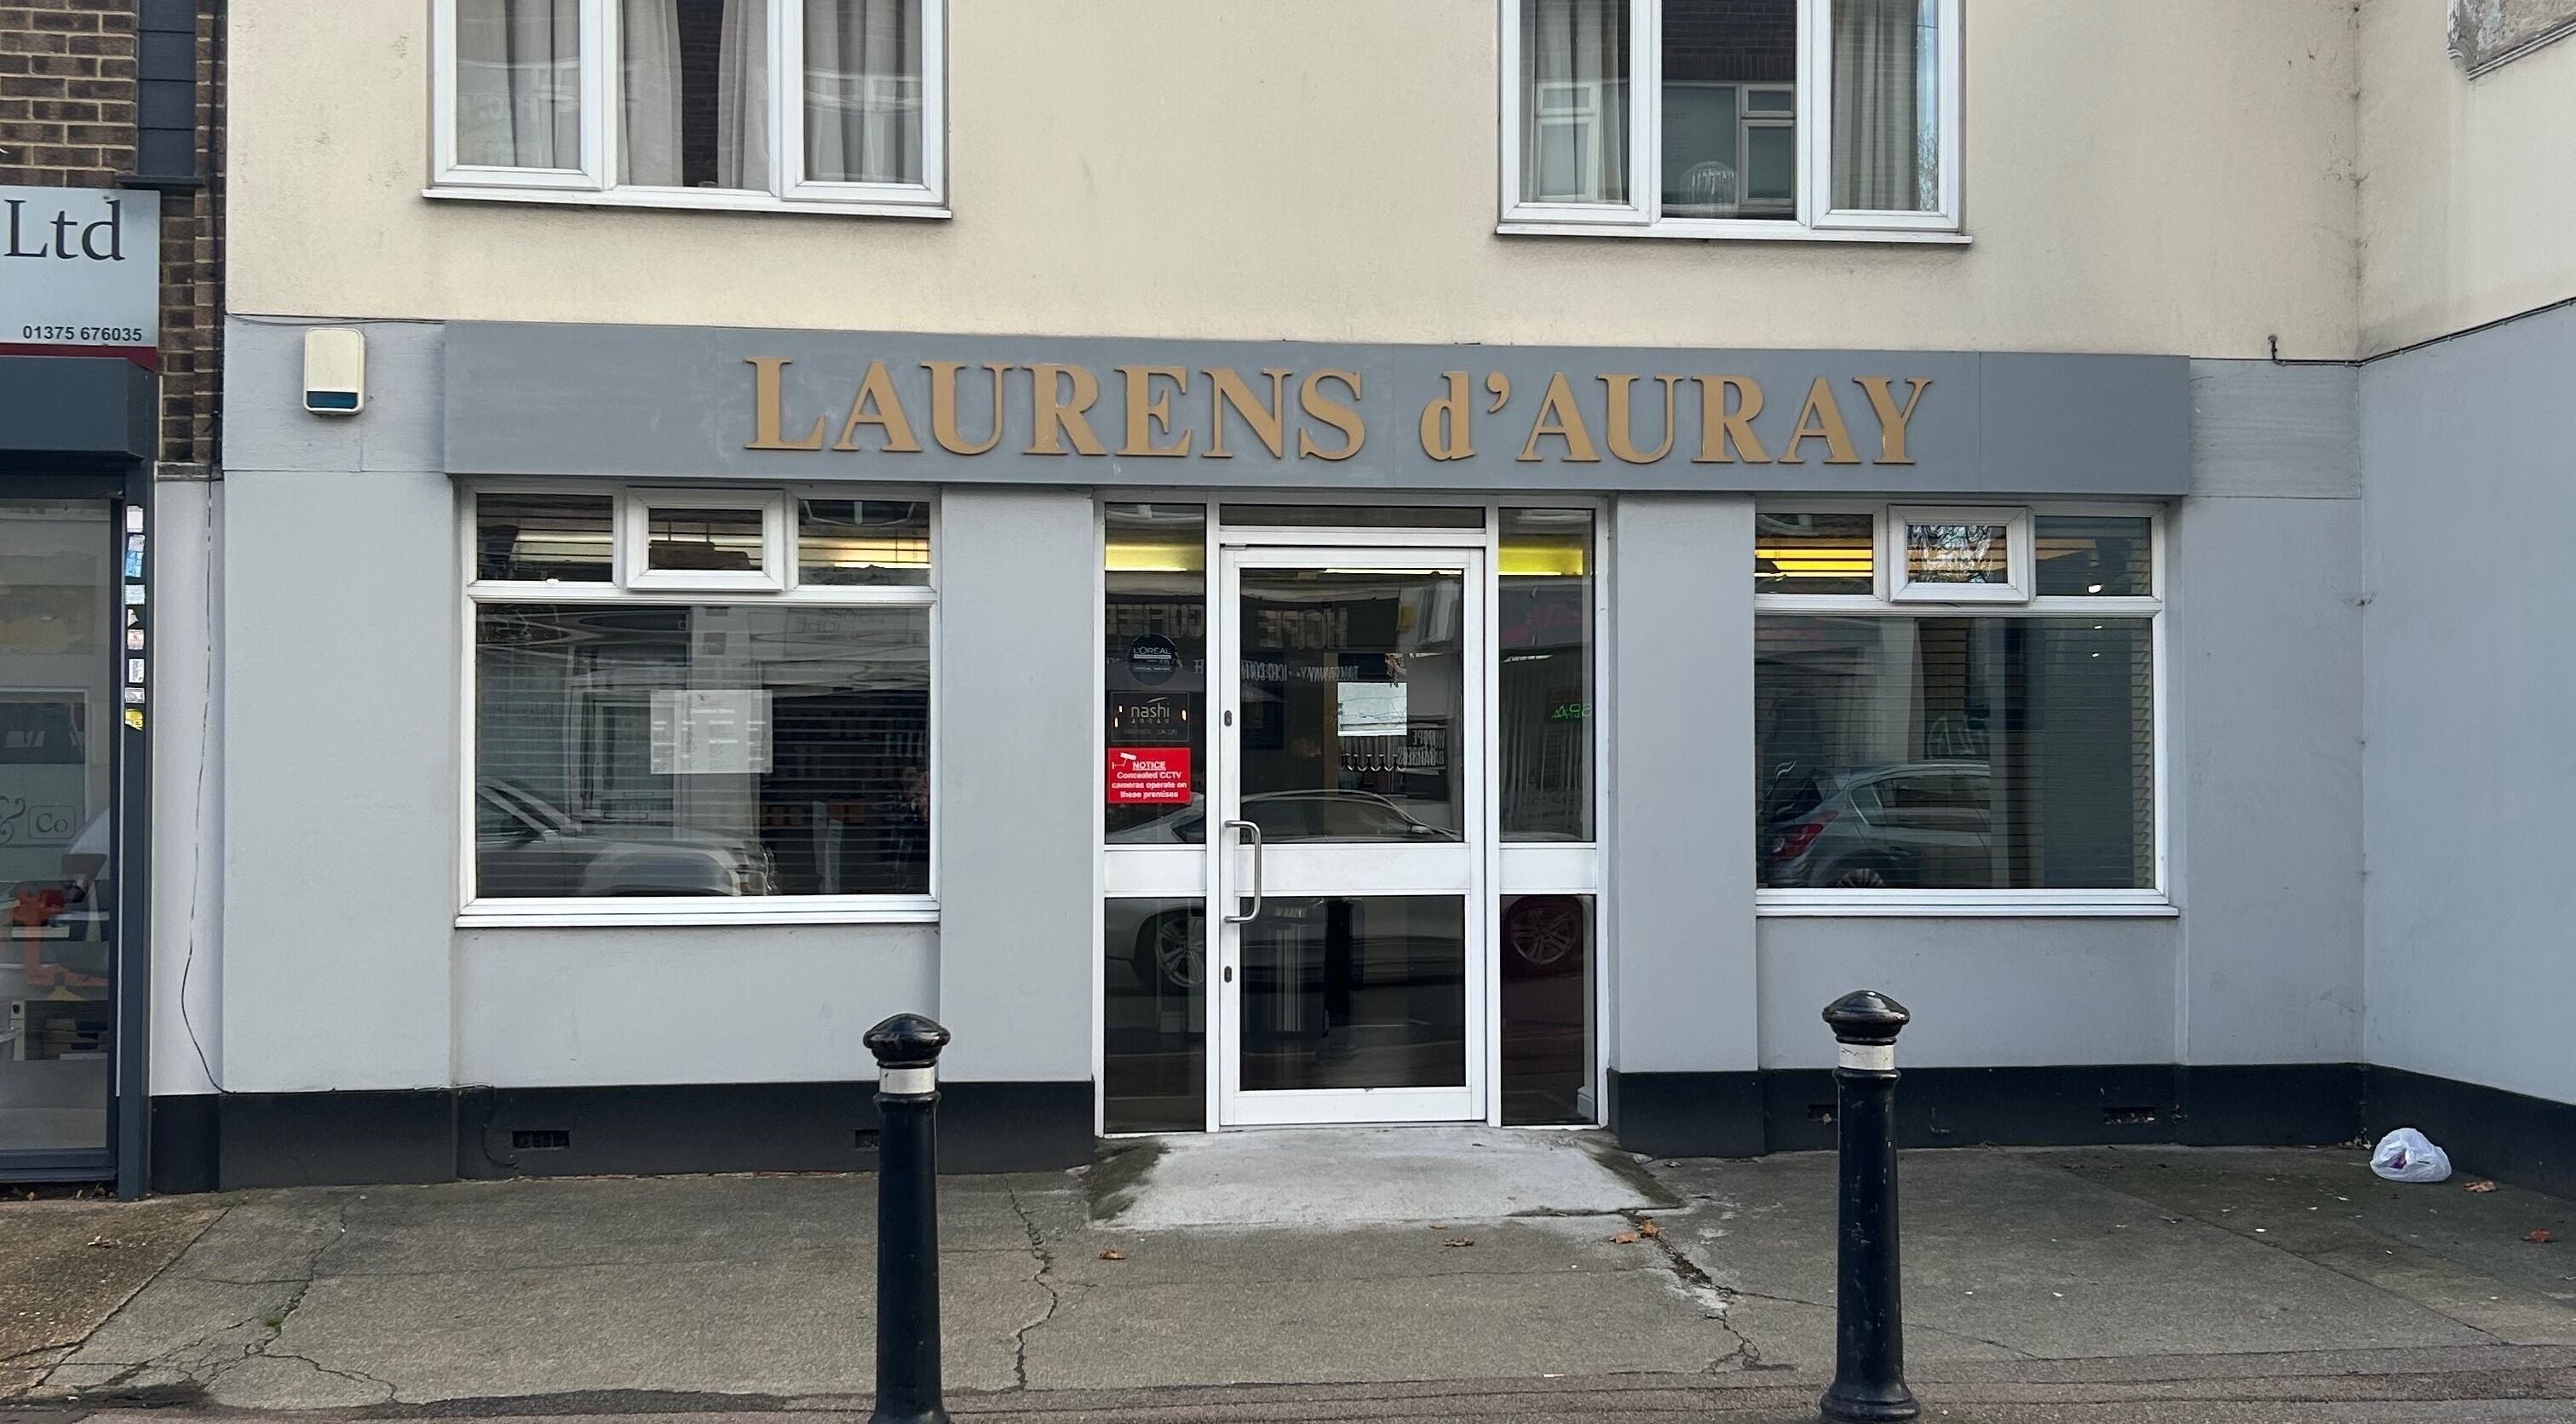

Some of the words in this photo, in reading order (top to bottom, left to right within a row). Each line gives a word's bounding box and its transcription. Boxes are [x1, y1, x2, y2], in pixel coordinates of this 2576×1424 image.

[3, 199, 126, 261] Ltd
[23, 325, 75, 340] 01375
[80, 327, 142, 342] 676035
[744, 355, 1366, 461] LAURENS
[1130, 702, 1170, 718] nashi
[1132, 761, 1167, 770] NOTICE
[1117, 771, 1158, 779] Concealed
[1159, 771, 1182, 779] CCTV
[1146, 781, 1176, 790] operate
[1143, 790, 1179, 799] premises
[36, 812, 69, 833] Co
